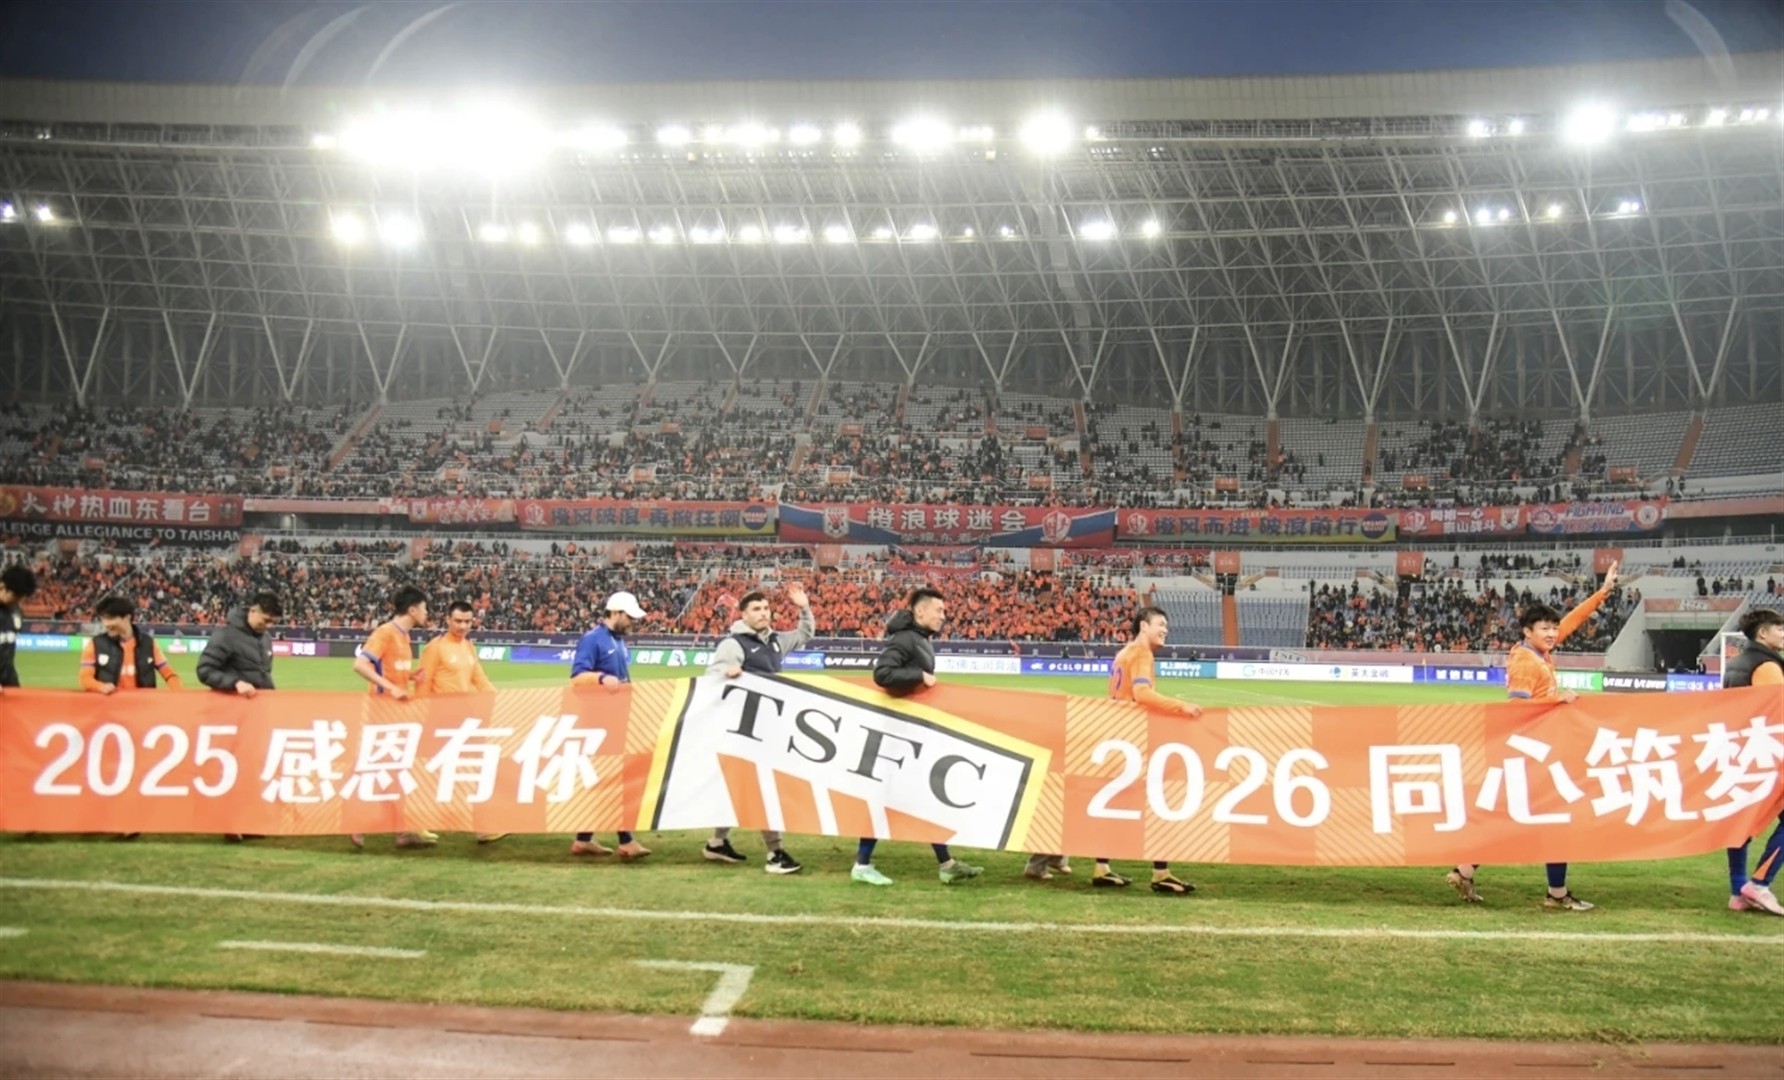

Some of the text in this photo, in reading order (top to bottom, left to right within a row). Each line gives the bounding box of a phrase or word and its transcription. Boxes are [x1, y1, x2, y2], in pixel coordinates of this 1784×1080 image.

[55, 525, 153, 539] ALLEGIANCE
[157, 528, 176, 539] TO
[867, 507, 1026, 531] 橙浪球迷会
[34, 714, 609, 804] 2025 感恩有你
[721, 684, 987, 809] TSFC
[1086, 715, 1784, 834] 2026 同心筑梦
